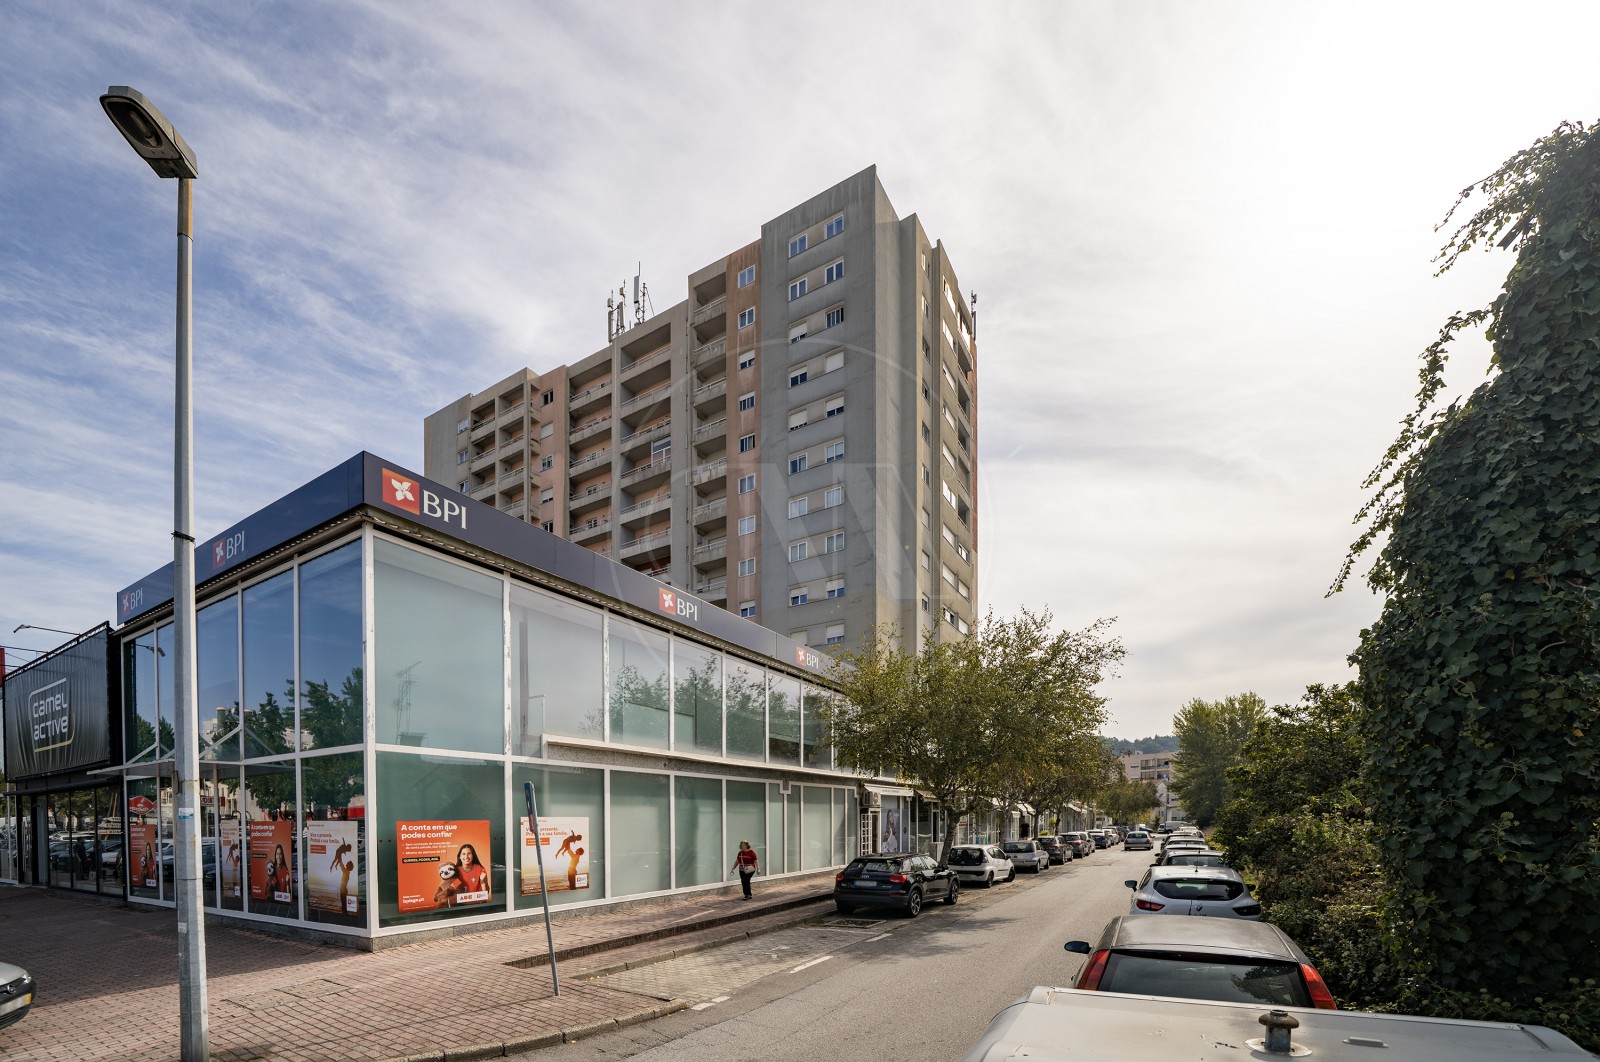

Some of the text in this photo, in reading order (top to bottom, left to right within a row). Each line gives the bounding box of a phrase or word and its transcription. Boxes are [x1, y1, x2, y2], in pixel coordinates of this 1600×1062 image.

[423, 490, 467, 529] BPI
[226, 531, 245, 560] BPI
[130, 588, 143, 610] BPI
[677, 598, 697, 621] BPI
[806, 655, 818, 669] BPI
[32, 693, 68, 718] camel
[401, 832, 426, 840] podes
